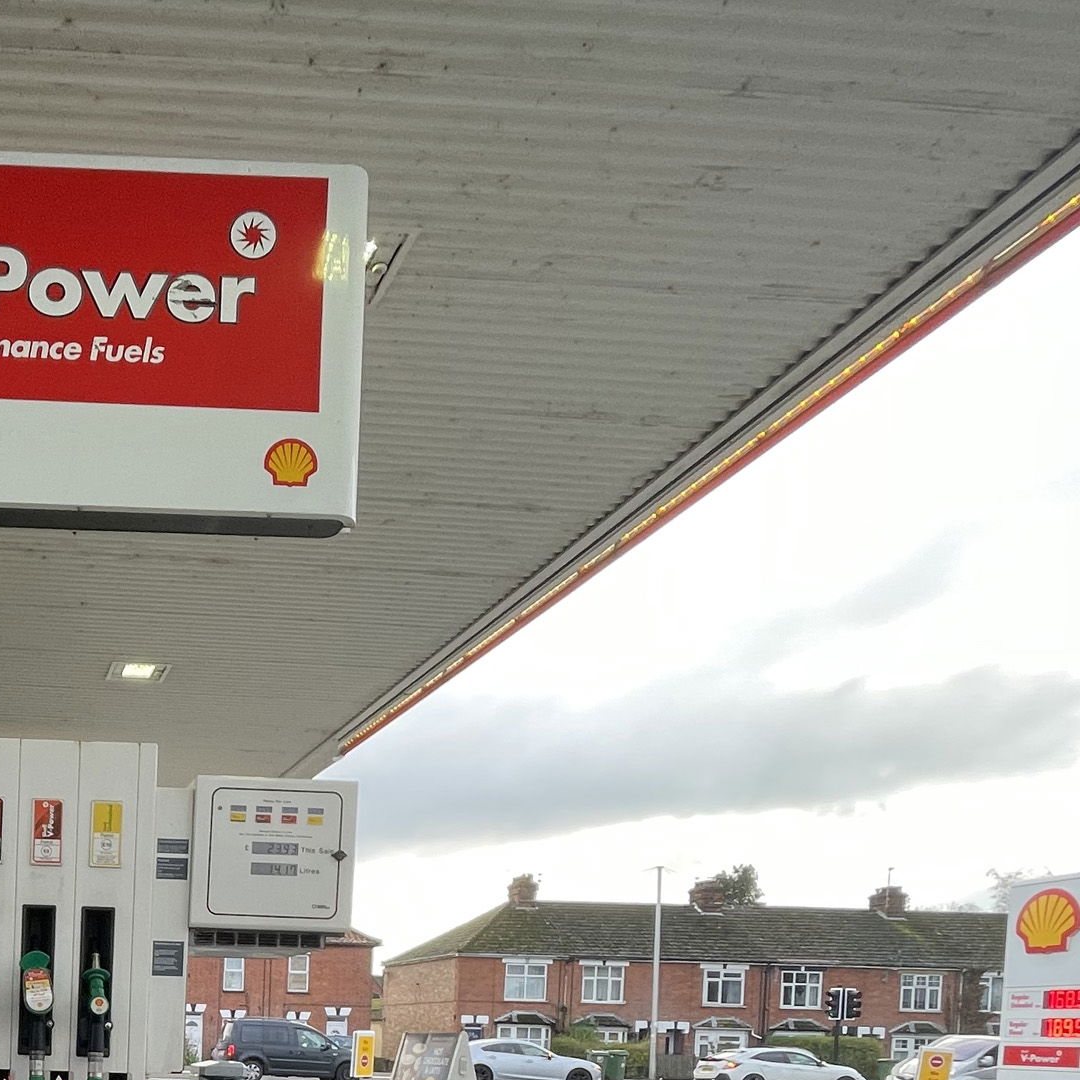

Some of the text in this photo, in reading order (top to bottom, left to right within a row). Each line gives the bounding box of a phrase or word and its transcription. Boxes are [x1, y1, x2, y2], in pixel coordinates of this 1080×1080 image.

[89, 336, 165, 364] Fuels
[47, 804, 56, 837] V-Power
[1020, 1053, 1060, 1063] V-Power
